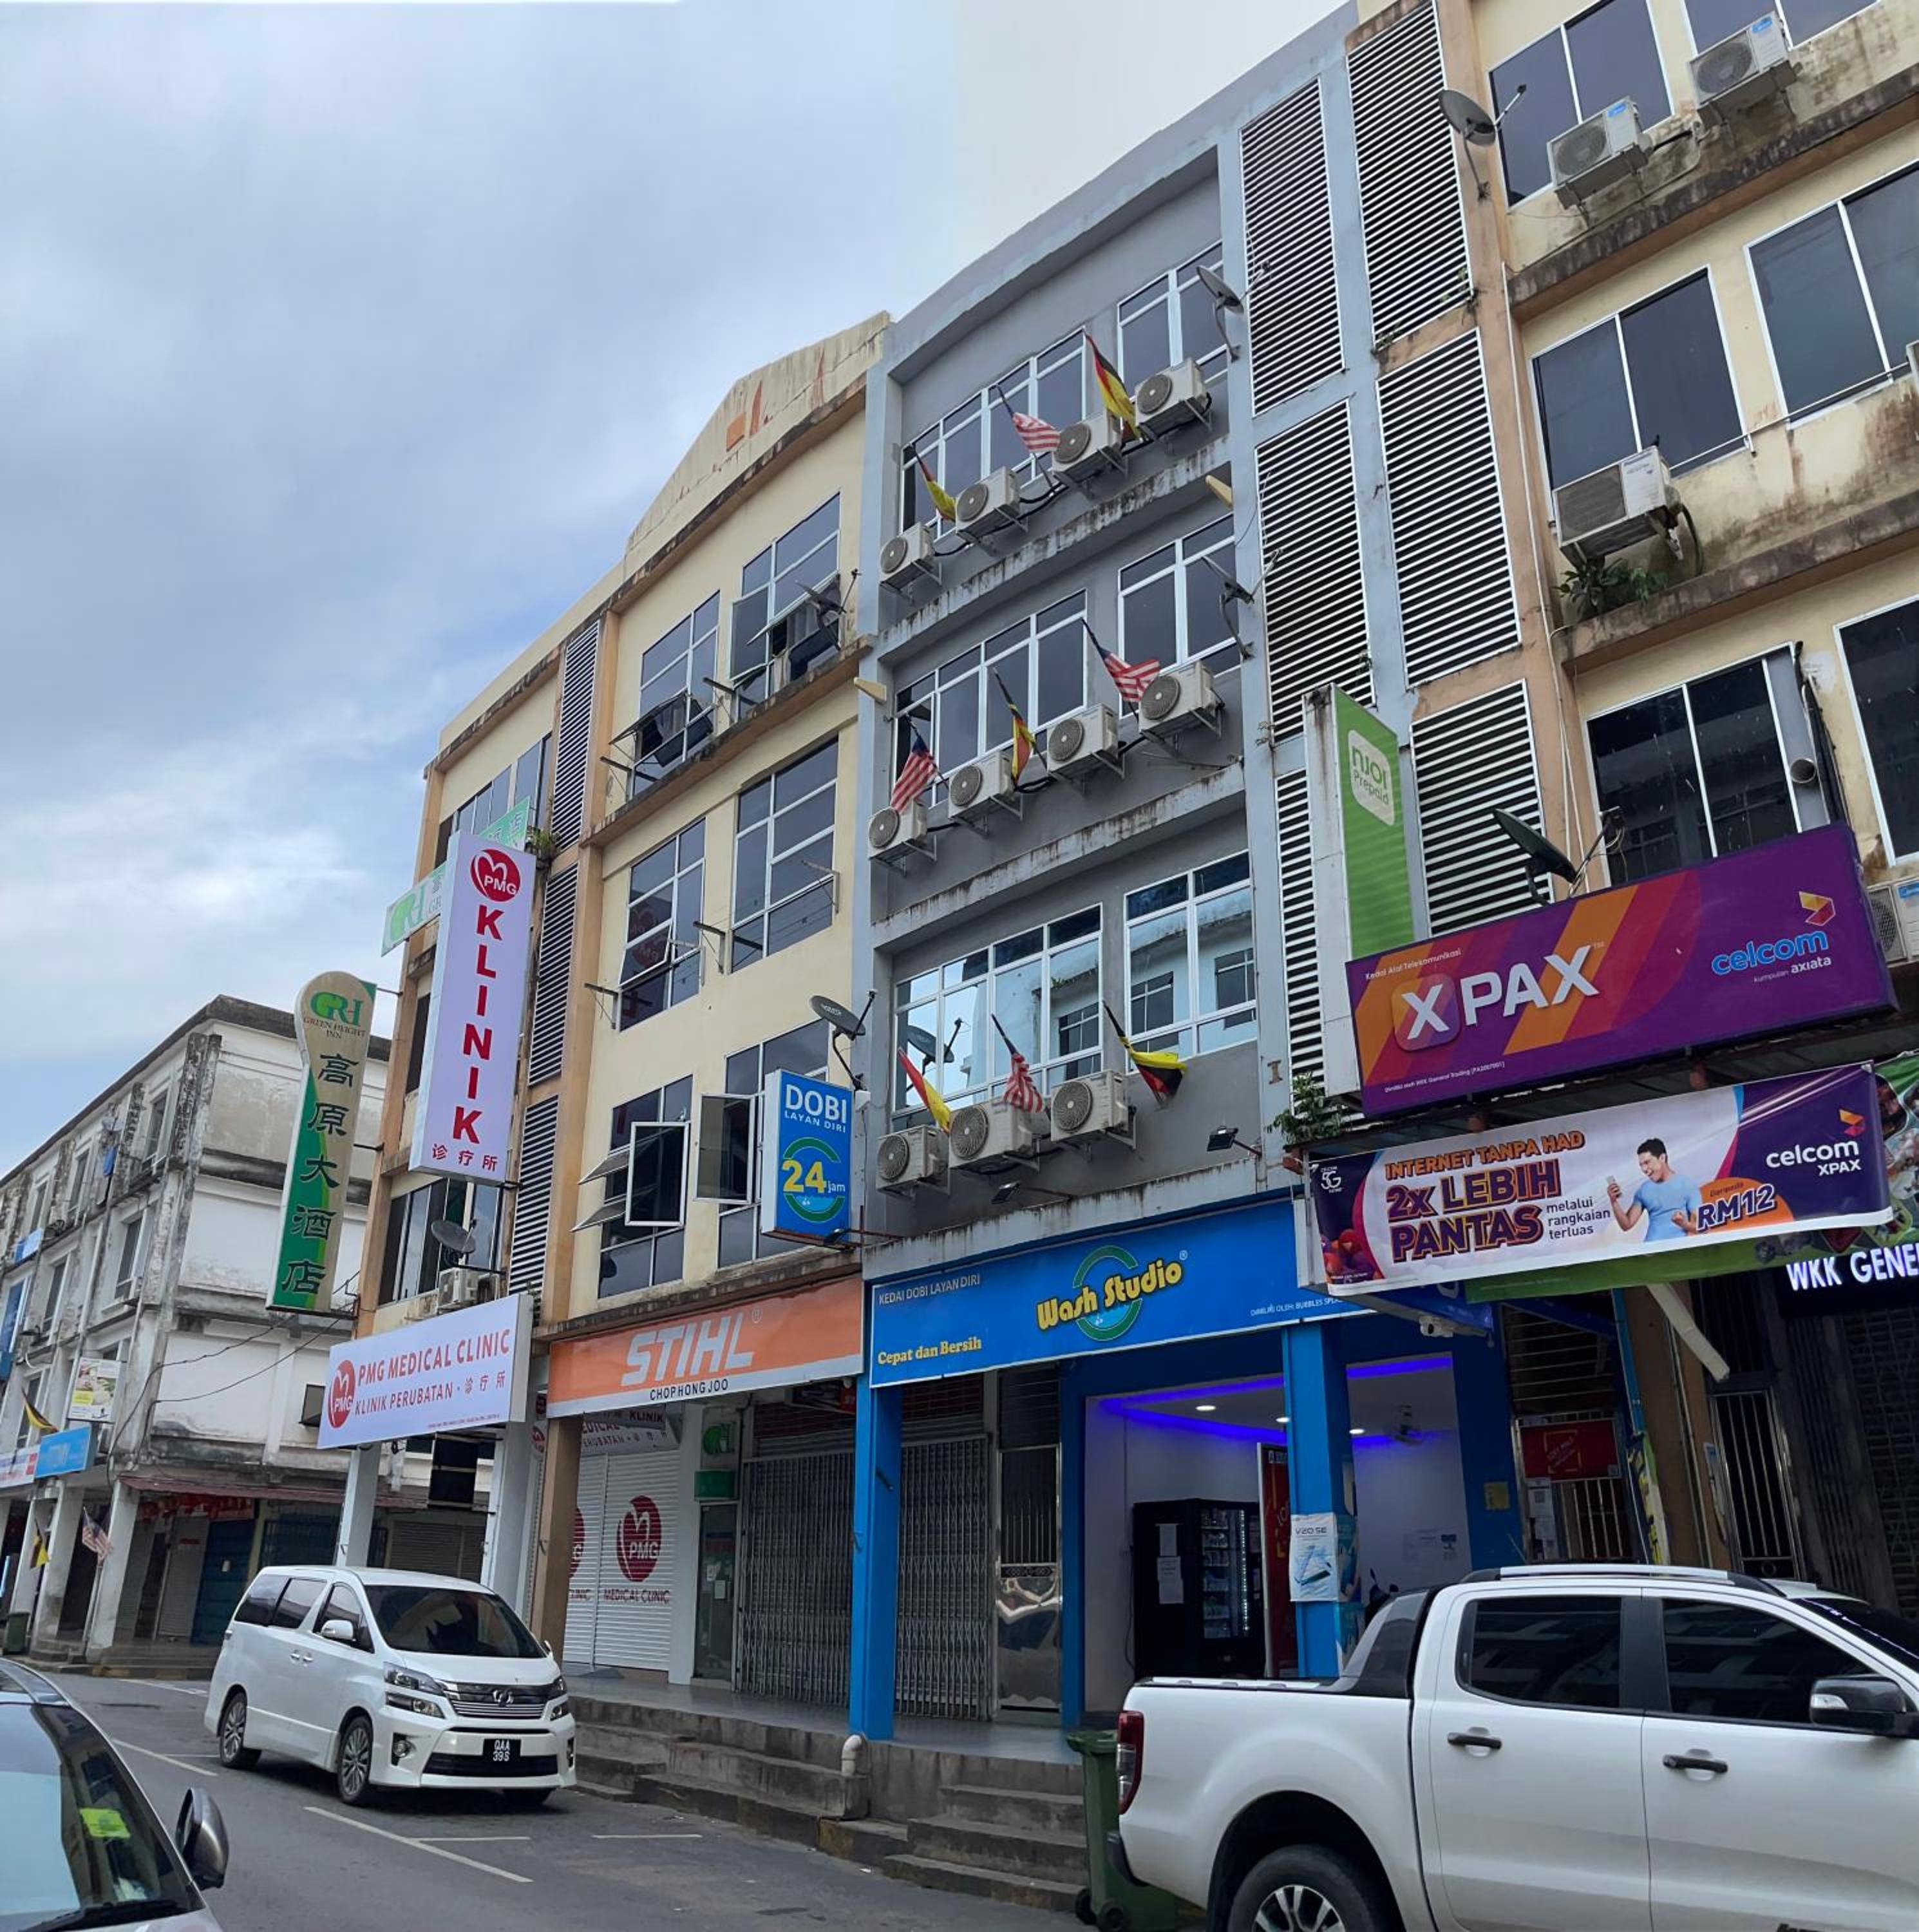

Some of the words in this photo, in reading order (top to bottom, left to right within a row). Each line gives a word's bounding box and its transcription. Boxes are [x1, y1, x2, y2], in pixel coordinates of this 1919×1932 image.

[484, 875, 517, 895] PMG
[1712, 931, 1829, 975] celcom
[1790, 956, 1831, 974] axiata
[452, 904, 504, 1145] KLINIK
[785, 1084, 847, 1124] DOBI
[784, 1110, 820, 1126] LAYAN
[824, 1121, 846, 1133] DIRI
[432, 1143, 498, 1171] 诊疗所
[1385, 1149, 1475, 1181] INTERNET
[1475, 1139, 1540, 1165] TANPA
[1541, 1130, 1586, 1154] HAD
[1766, 1140, 1860, 1168] celcom
[1817, 1159, 1862, 1177] XPAX
[281, 1052, 359, 1294] 高原大酒店
[782, 1159, 827, 1194] 24
[827, 1181, 846, 1193] jam
[1321, 1170, 1341, 1190] 5G
[1440, 1159, 1562, 1215] LEBIH
[1546, 1196, 1594, 1214] melalui
[1547, 1209, 1611, 1227] rangkaian
[1696, 1183, 1777, 1232] RM12
[1390, 1204, 1544, 1264] PANTAS
[1549, 1224, 1594, 1240] terluas
[1786, 1256, 1842, 1291] WKK
[1849, 1243, 1919, 1283] GENE
[878, 1292, 905, 1305] KEDAI
[906, 1287, 928, 1299] DOBI
[930, 1278, 959, 1296] LAYAN
[960, 1273, 981, 1288] DIRI
[1037, 1285, 1099, 1331] Wash
[1104, 1259, 1182, 1308] Studio
[358, 1359, 384, 1386] PMG
[388, 1344, 452, 1380] MEDICAL
[456, 1329, 511, 1364] CLINIC
[621, 1312, 755, 1387] STIHL
[878, 1349, 912, 1366] Cepat
[915, 1345, 938, 1359] dan
[940, 1336, 982, 1355] Bersih
[464, 1370, 506, 1394] 诊疗所
[708, 1378, 729, 1393] JOO
[334, 1394, 353, 1413] PMG
[355, 1393, 387, 1416] KLINIK
[390, 1381, 453, 1410] PERUBATAN
[629, 1410, 664, 1423] KLINIK
[629, 1541, 659, 1559] PMG
[603, 1589, 639, 1602] MEDICAL
[641, 1589, 670, 1604] CLINIC
[494, 1739, 510, 1751] QAA
